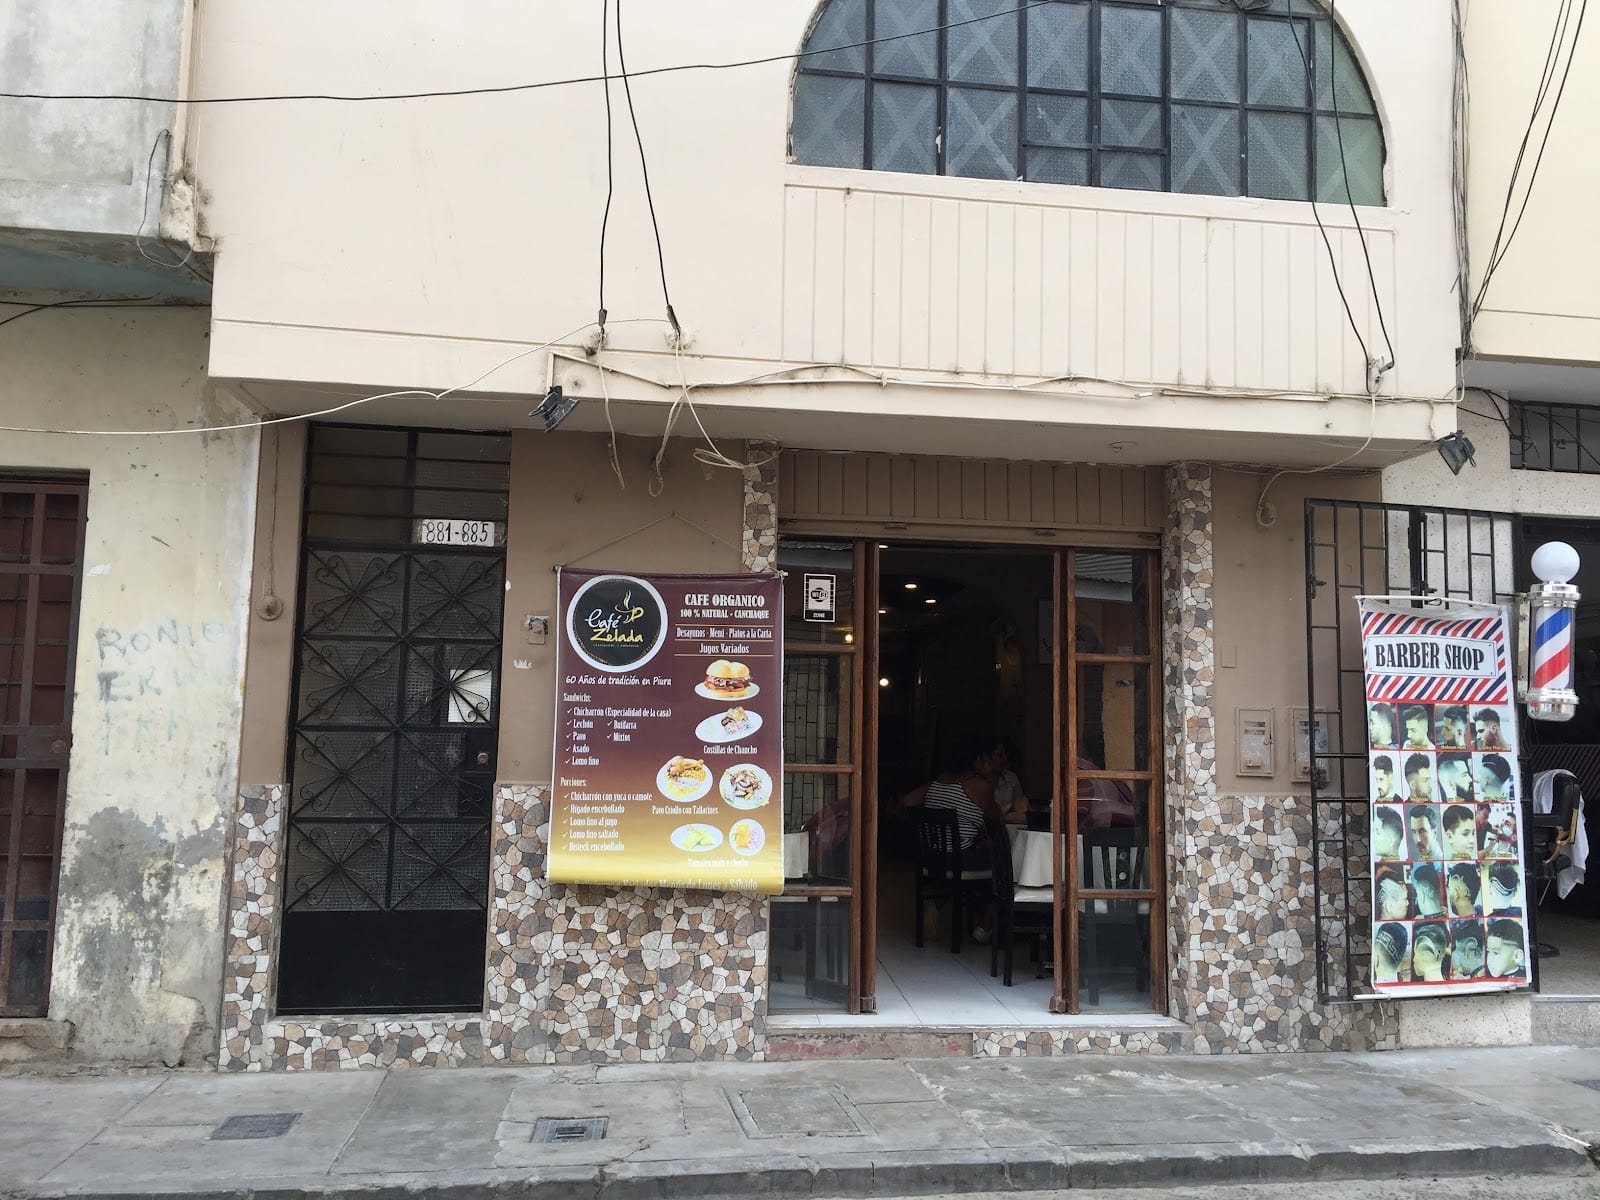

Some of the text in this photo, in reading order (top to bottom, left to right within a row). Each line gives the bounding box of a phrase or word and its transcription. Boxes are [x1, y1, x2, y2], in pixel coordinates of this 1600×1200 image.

[426, 521, 489, 543] 881-885
[684, 593, 765, 607] CAFE ORGANICO
[584, 608, 622, 632] Café
[680, 609, 692, 618] 100
[701, 609, 729, 619] NATURAL
[734, 609, 770, 620] CANCHAQUE
[590, 628, 644, 643] Zelada
[756, 628, 772, 639] Carta
[699, 642, 750, 654] Jugos Variados
[1375, 642, 1485, 671] BARBER SHOP
[565, 675, 672, 686] 60 Años de tradición en Piura
[642, 708, 649, 717] de
[572, 731, 586, 741] Pavo
[572, 744, 590, 753] Asado
[703, 745, 758, 755] Costillas de Chancho
[571, 756, 600, 766] Lomo fino
[602, 793, 613, 801] con
[613, 793, 627, 802] yuca
[632, 792, 653, 801] camote
[651, 805, 665, 815] Pavo
[682, 807, 692, 815] con
